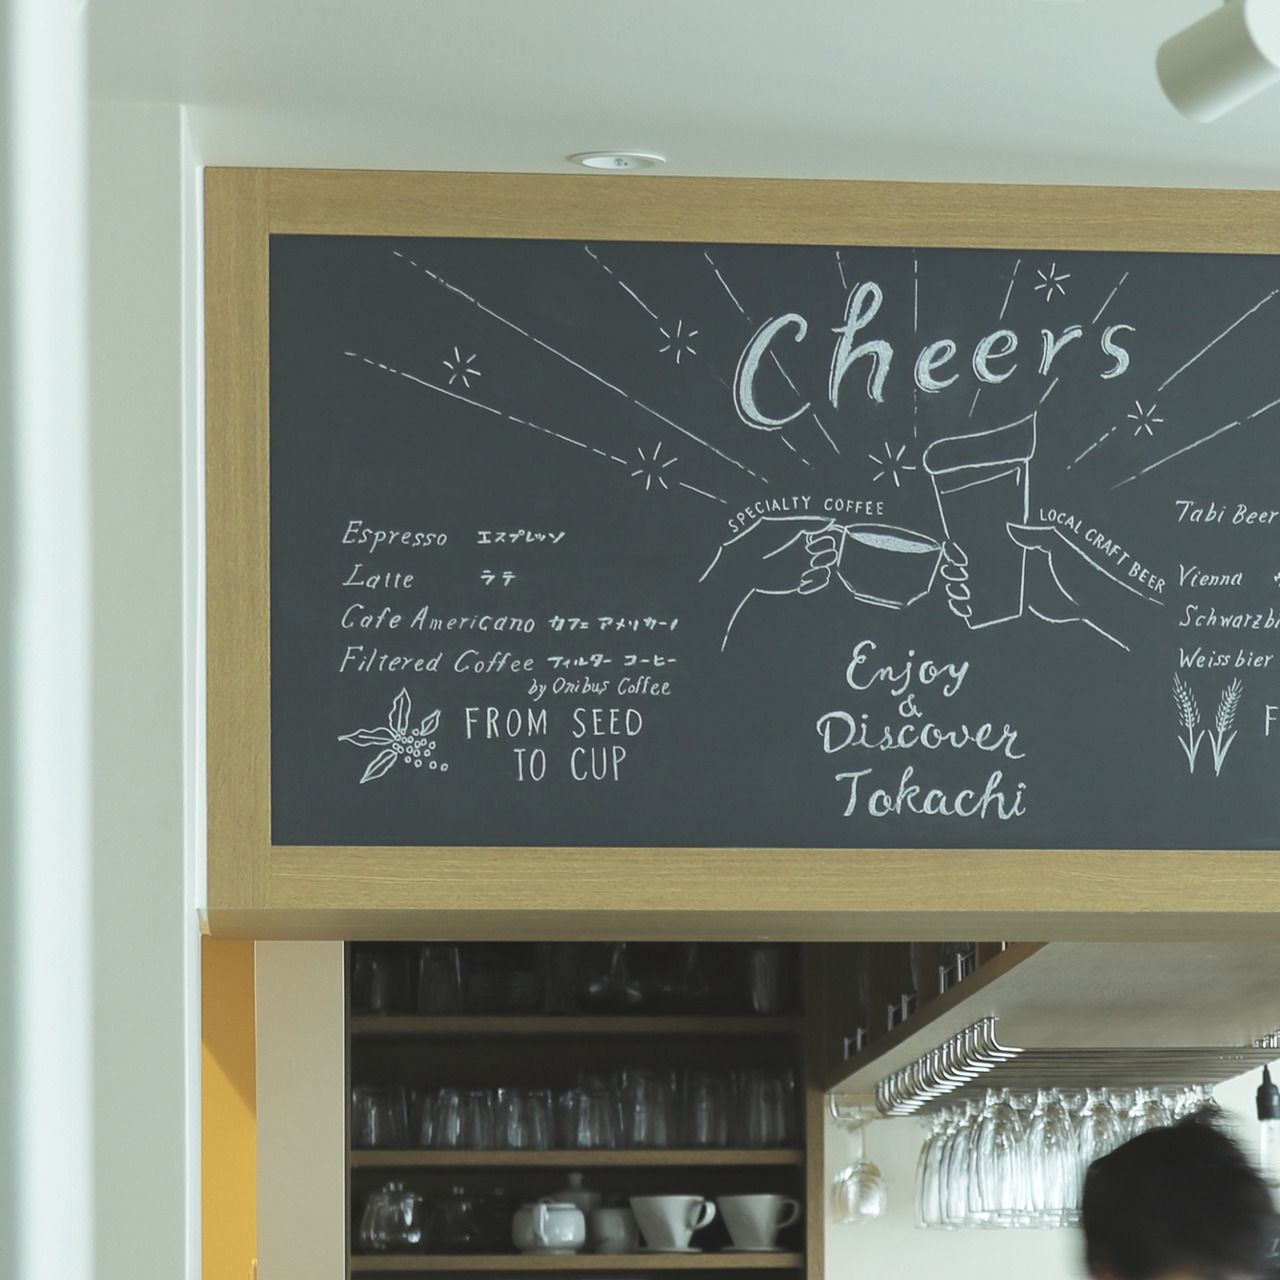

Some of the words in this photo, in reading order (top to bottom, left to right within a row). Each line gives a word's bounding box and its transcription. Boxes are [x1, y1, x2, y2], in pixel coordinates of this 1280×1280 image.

[733, 282, 1135, 431] Cheers
[728, 496, 811, 533] SPECIALTY
[825, 498, 883, 515] COFFEE
[1176, 500, 1226, 523] Tabi
[1232, 504, 1279, 524] Beer
[342, 520, 447, 553] Espresso
[477, 529, 565, 544] エスプレッソ
[1039, 507, 1082, 535] LOCAL
[1086, 530, 1129, 566] CRAFT
[1133, 561, 1165, 593] BEER
[342, 564, 414, 589] Latte
[480, 570, 516, 587] ラテ
[1180, 564, 1243, 587] Vienna
[341, 603, 402, 629] Cafe
[410, 605, 535, 633] Americano
[339, 645, 443, 672] Filtered
[454, 649, 534, 673] Coffee
[624, 654, 677, 667] コーヒー
[847, 640, 969, 696] Enjoy
[528, 678, 547, 702] by
[553, 676, 610, 695] Onibus
[618, 676, 671, 695] Coffee
[899, 694, 922, 717] &
[465, 707, 547, 739] FROM
[573, 708, 642, 738] SEED
[816, 711, 1025, 759] Discover
[513, 748, 546, 781] TO
[571, 745, 626, 781] CUP
[836, 766, 1026, 819] Tokachi
